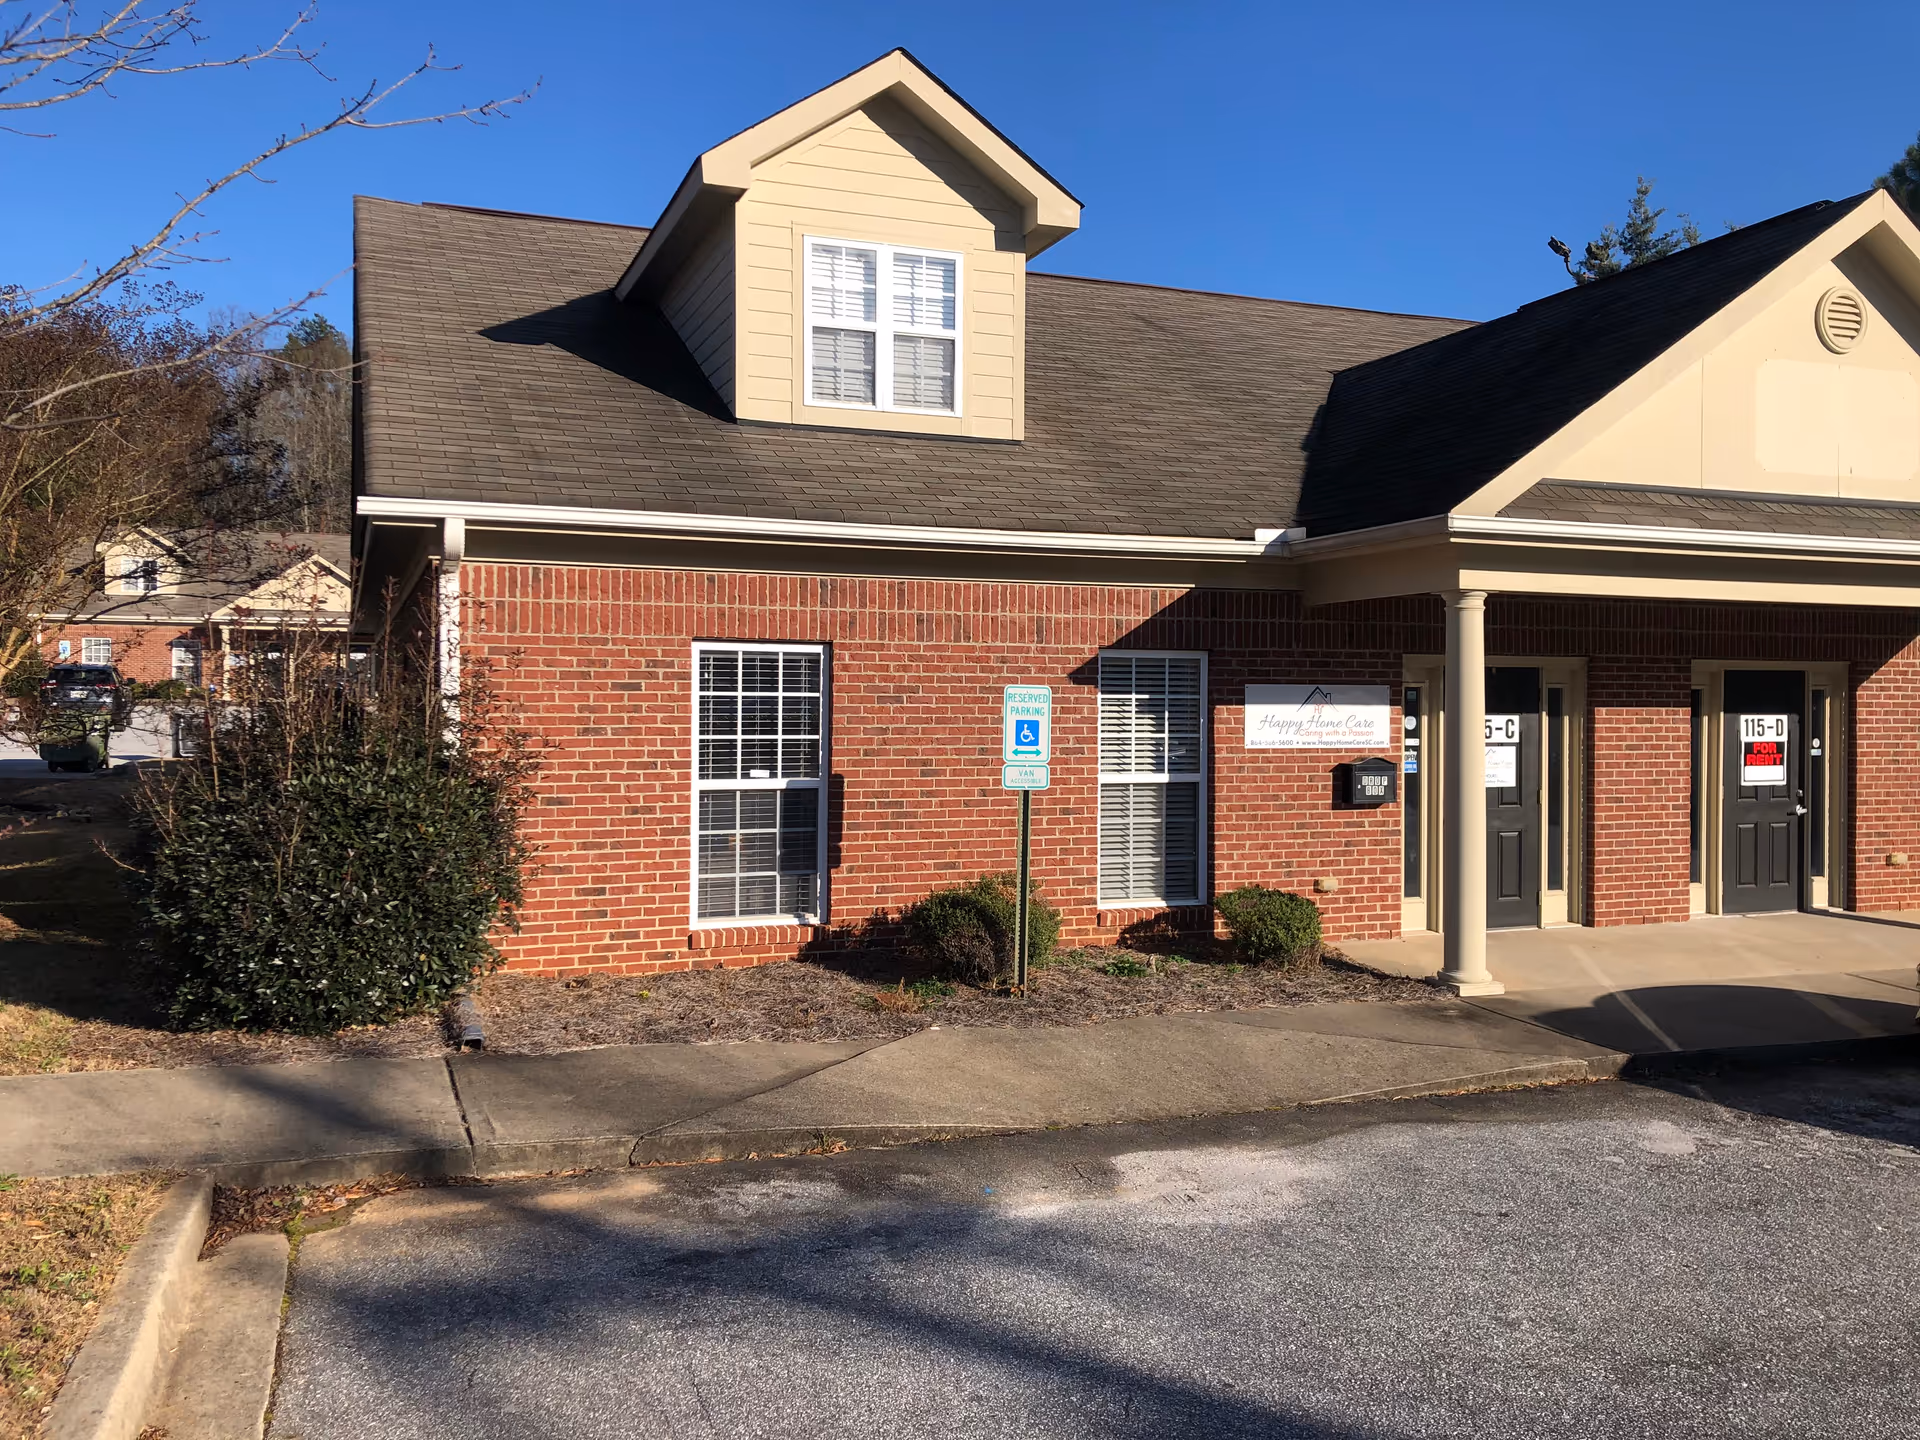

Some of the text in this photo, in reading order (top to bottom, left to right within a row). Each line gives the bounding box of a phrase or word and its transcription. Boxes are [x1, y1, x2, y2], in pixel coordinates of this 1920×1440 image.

[1008, 693, 1048, 703] RESERVED
[1010, 706, 1045, 716] PARKING
[1257, 714, 1375, 735] Happy Home Care
[1744, 718, 1784, 736] 115-D
[1299, 729, 1323, 738] Caring
[1753, 742, 1777, 753] FOR
[1746, 754, 1782, 766] RENT
[1362, 776, 1387, 785] DROP
[1366, 786, 1384, 795] BOX
